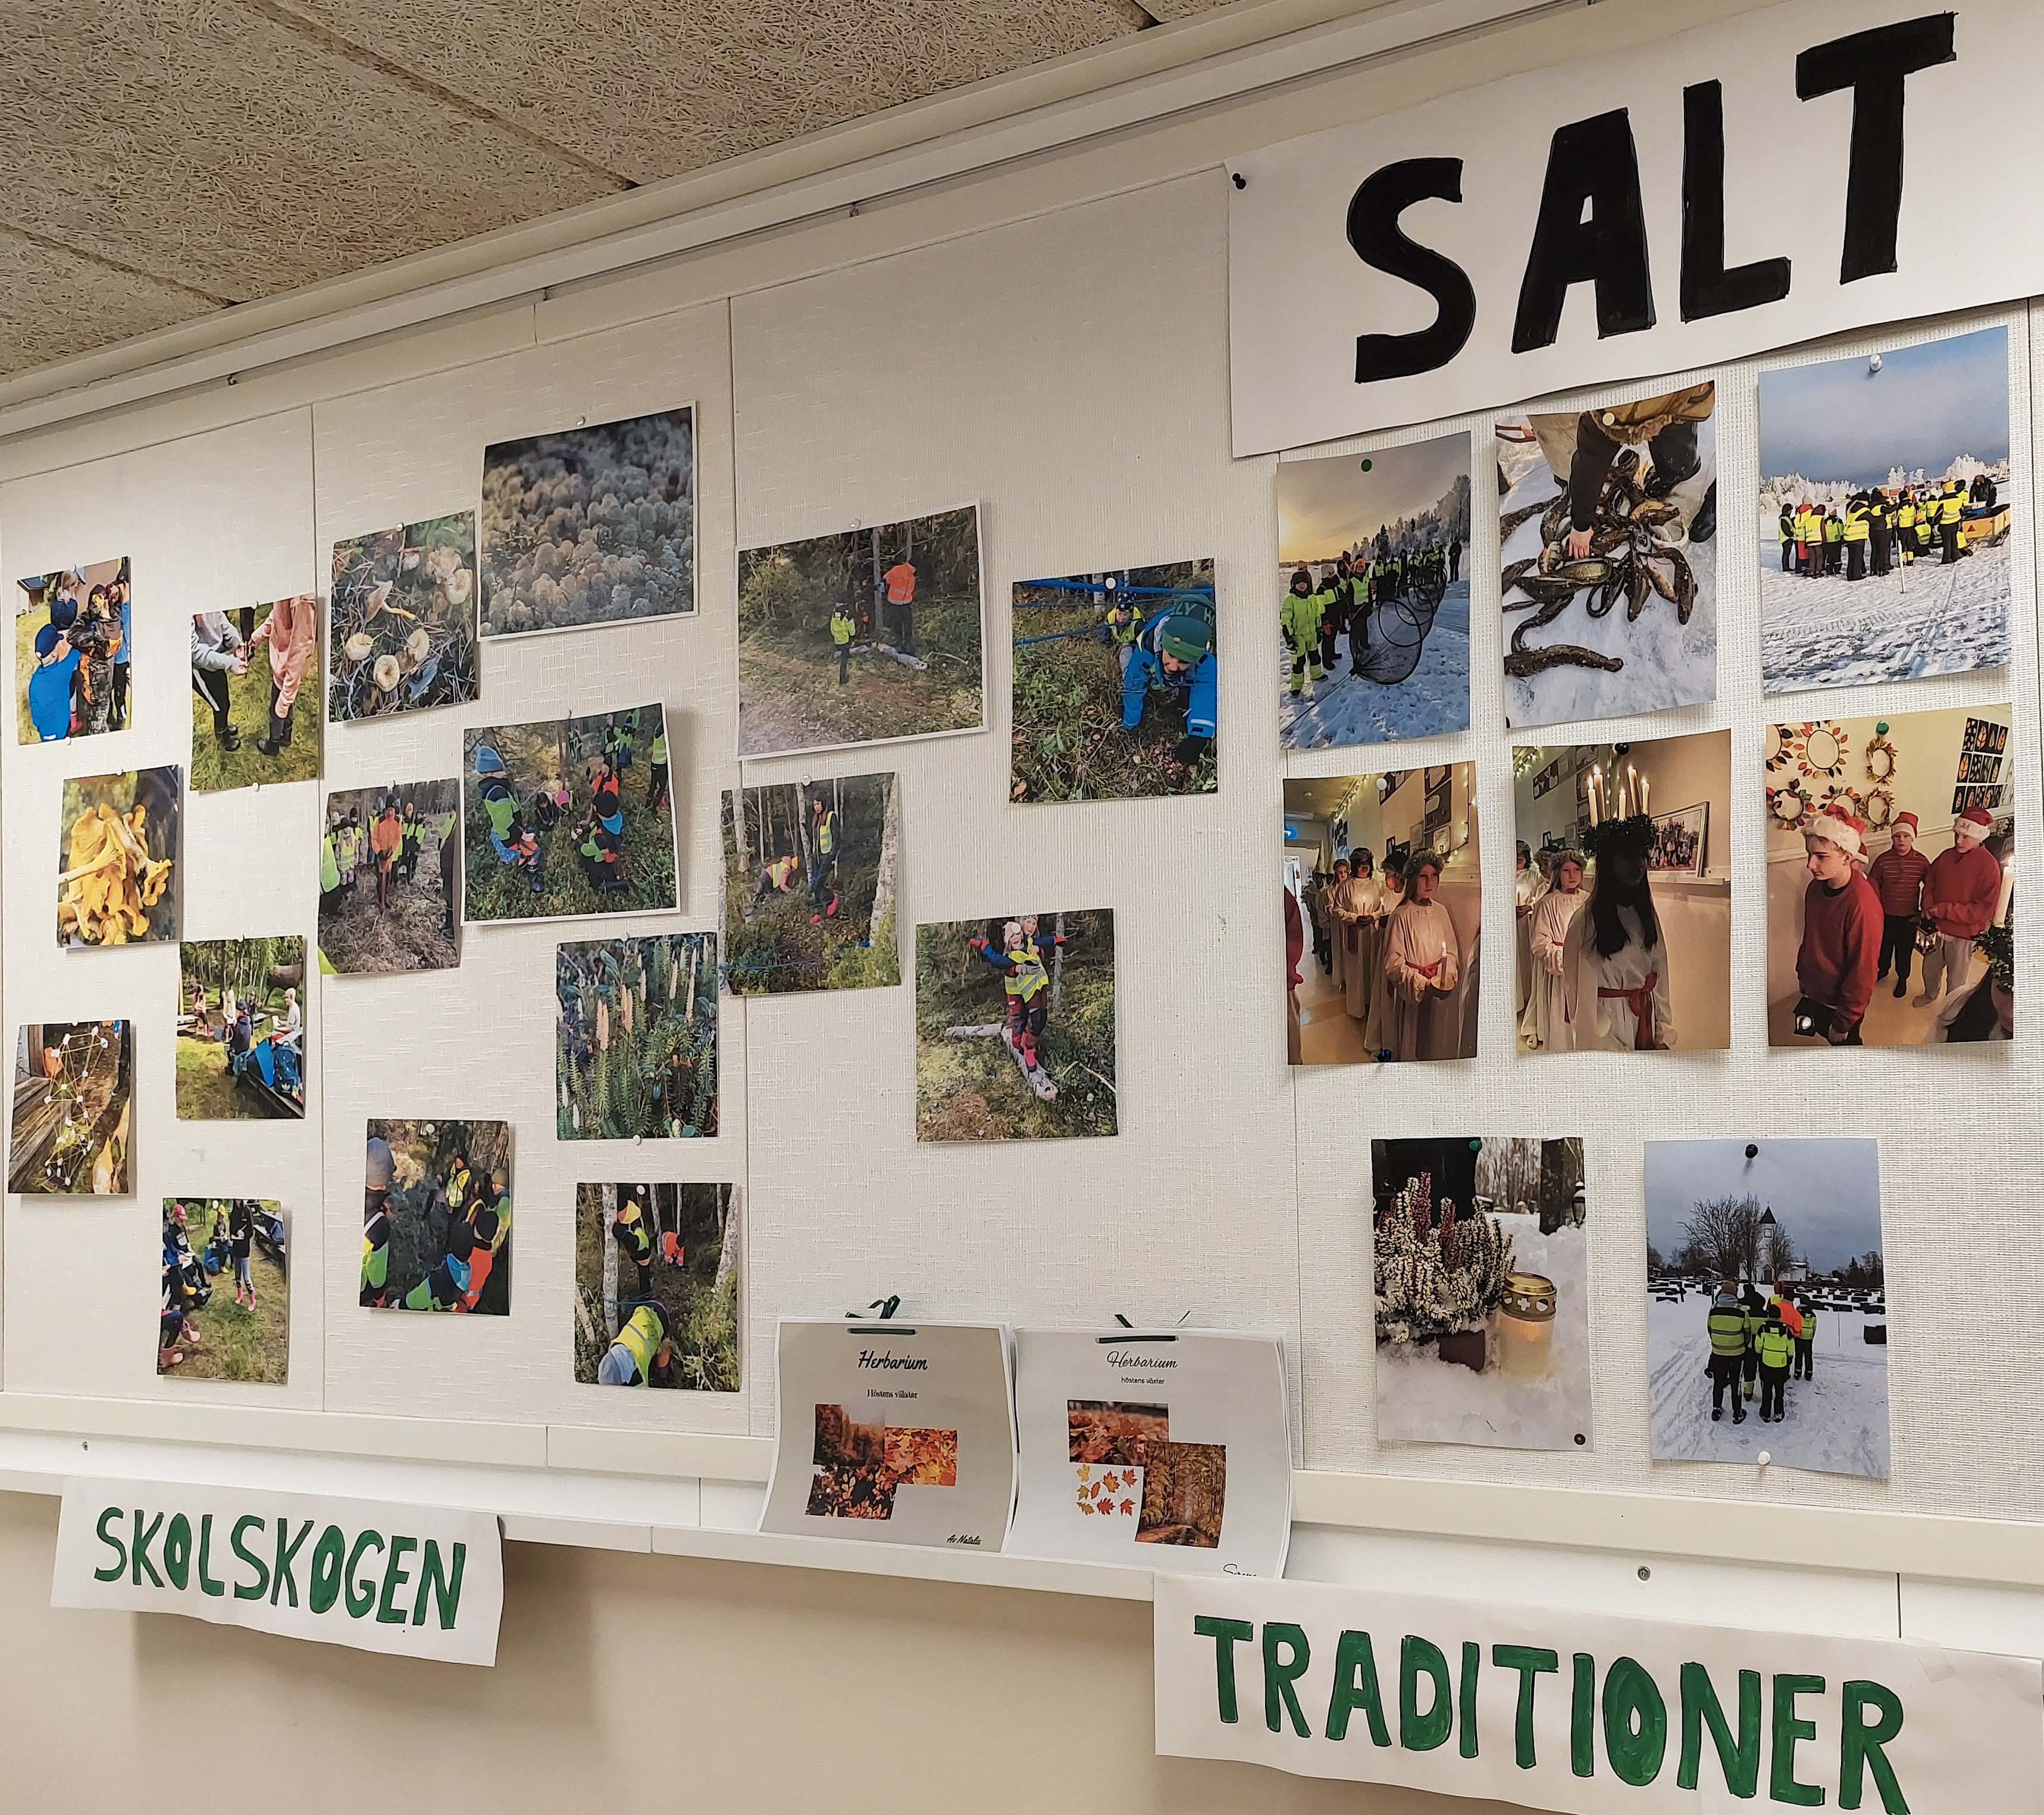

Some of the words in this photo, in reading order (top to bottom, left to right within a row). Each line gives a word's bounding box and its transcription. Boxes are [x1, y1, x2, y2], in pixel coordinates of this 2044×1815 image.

[1347, 10, 1958, 384] SALT
[858, 1350, 928, 1370] Herbarium
[1107, 1350, 1178, 1368] Herbarium
[867, 1388, 893, 1398] Höstens
[946, 1534, 957, 1544] Av
[94, 1507, 467, 1630] SKOLSKOGEN
[1194, 1614, 1911, 1815] TRADITIONER
